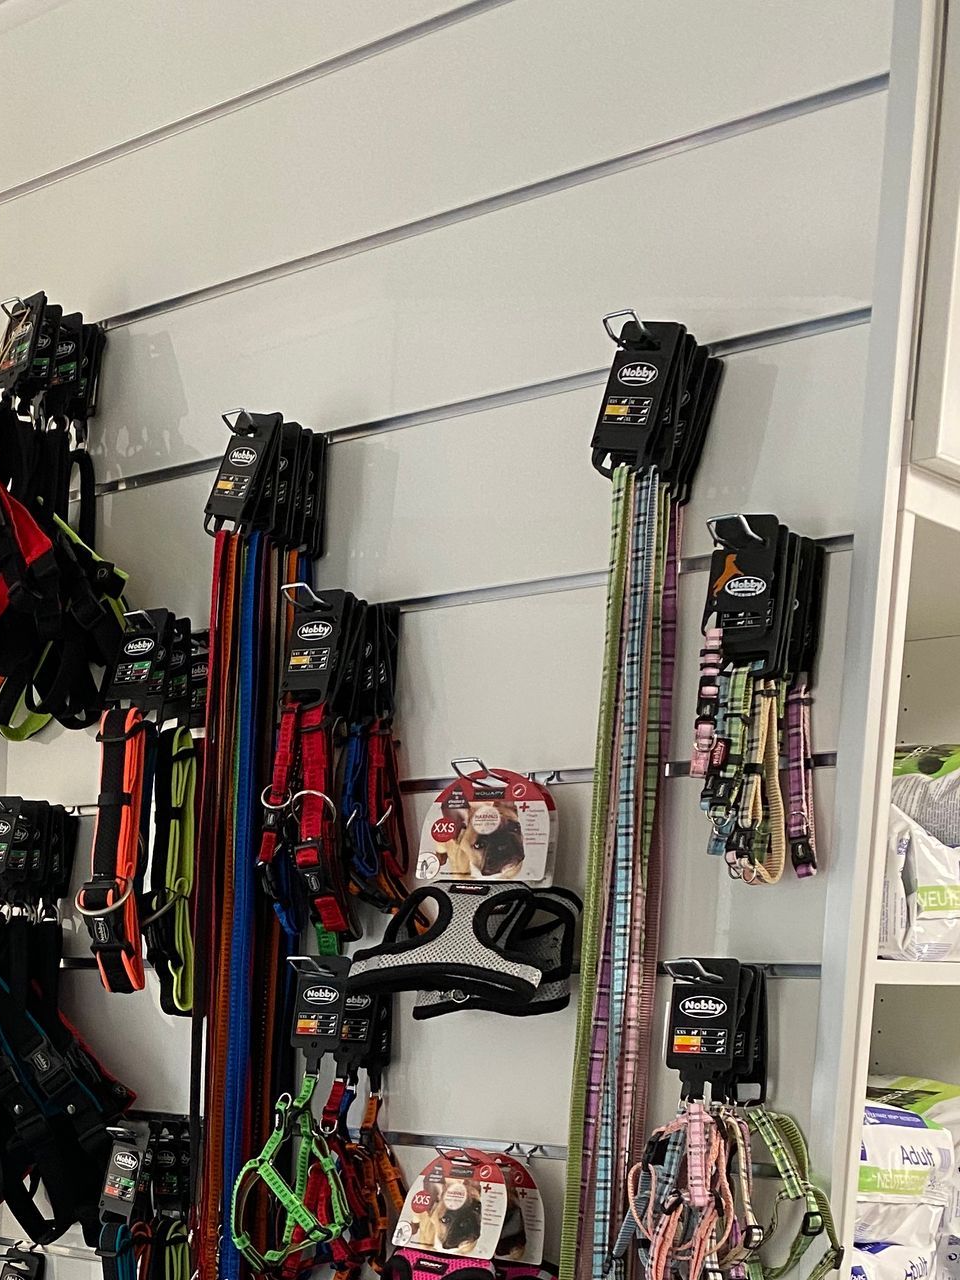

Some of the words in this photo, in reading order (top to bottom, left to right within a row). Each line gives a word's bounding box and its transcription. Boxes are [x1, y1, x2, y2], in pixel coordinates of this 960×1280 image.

[622, 366, 655, 381] Nobby
[232, 449, 256, 464] Nobby
[731, 579, 764, 592] Nobby
[301, 623, 331, 639] Nobby
[127, 640, 153, 653] Nobby
[433, 822, 455, 833] XXS
[307, 988, 337, 1002] Nobby
[346, 996, 369, 1007] obby
[684, 1000, 724, 1014] Nobby
[116, 1154, 137, 1168] Nobby
[901, 1145, 935, 1167] Adult
[413, 1195, 431, 1206] XXS
